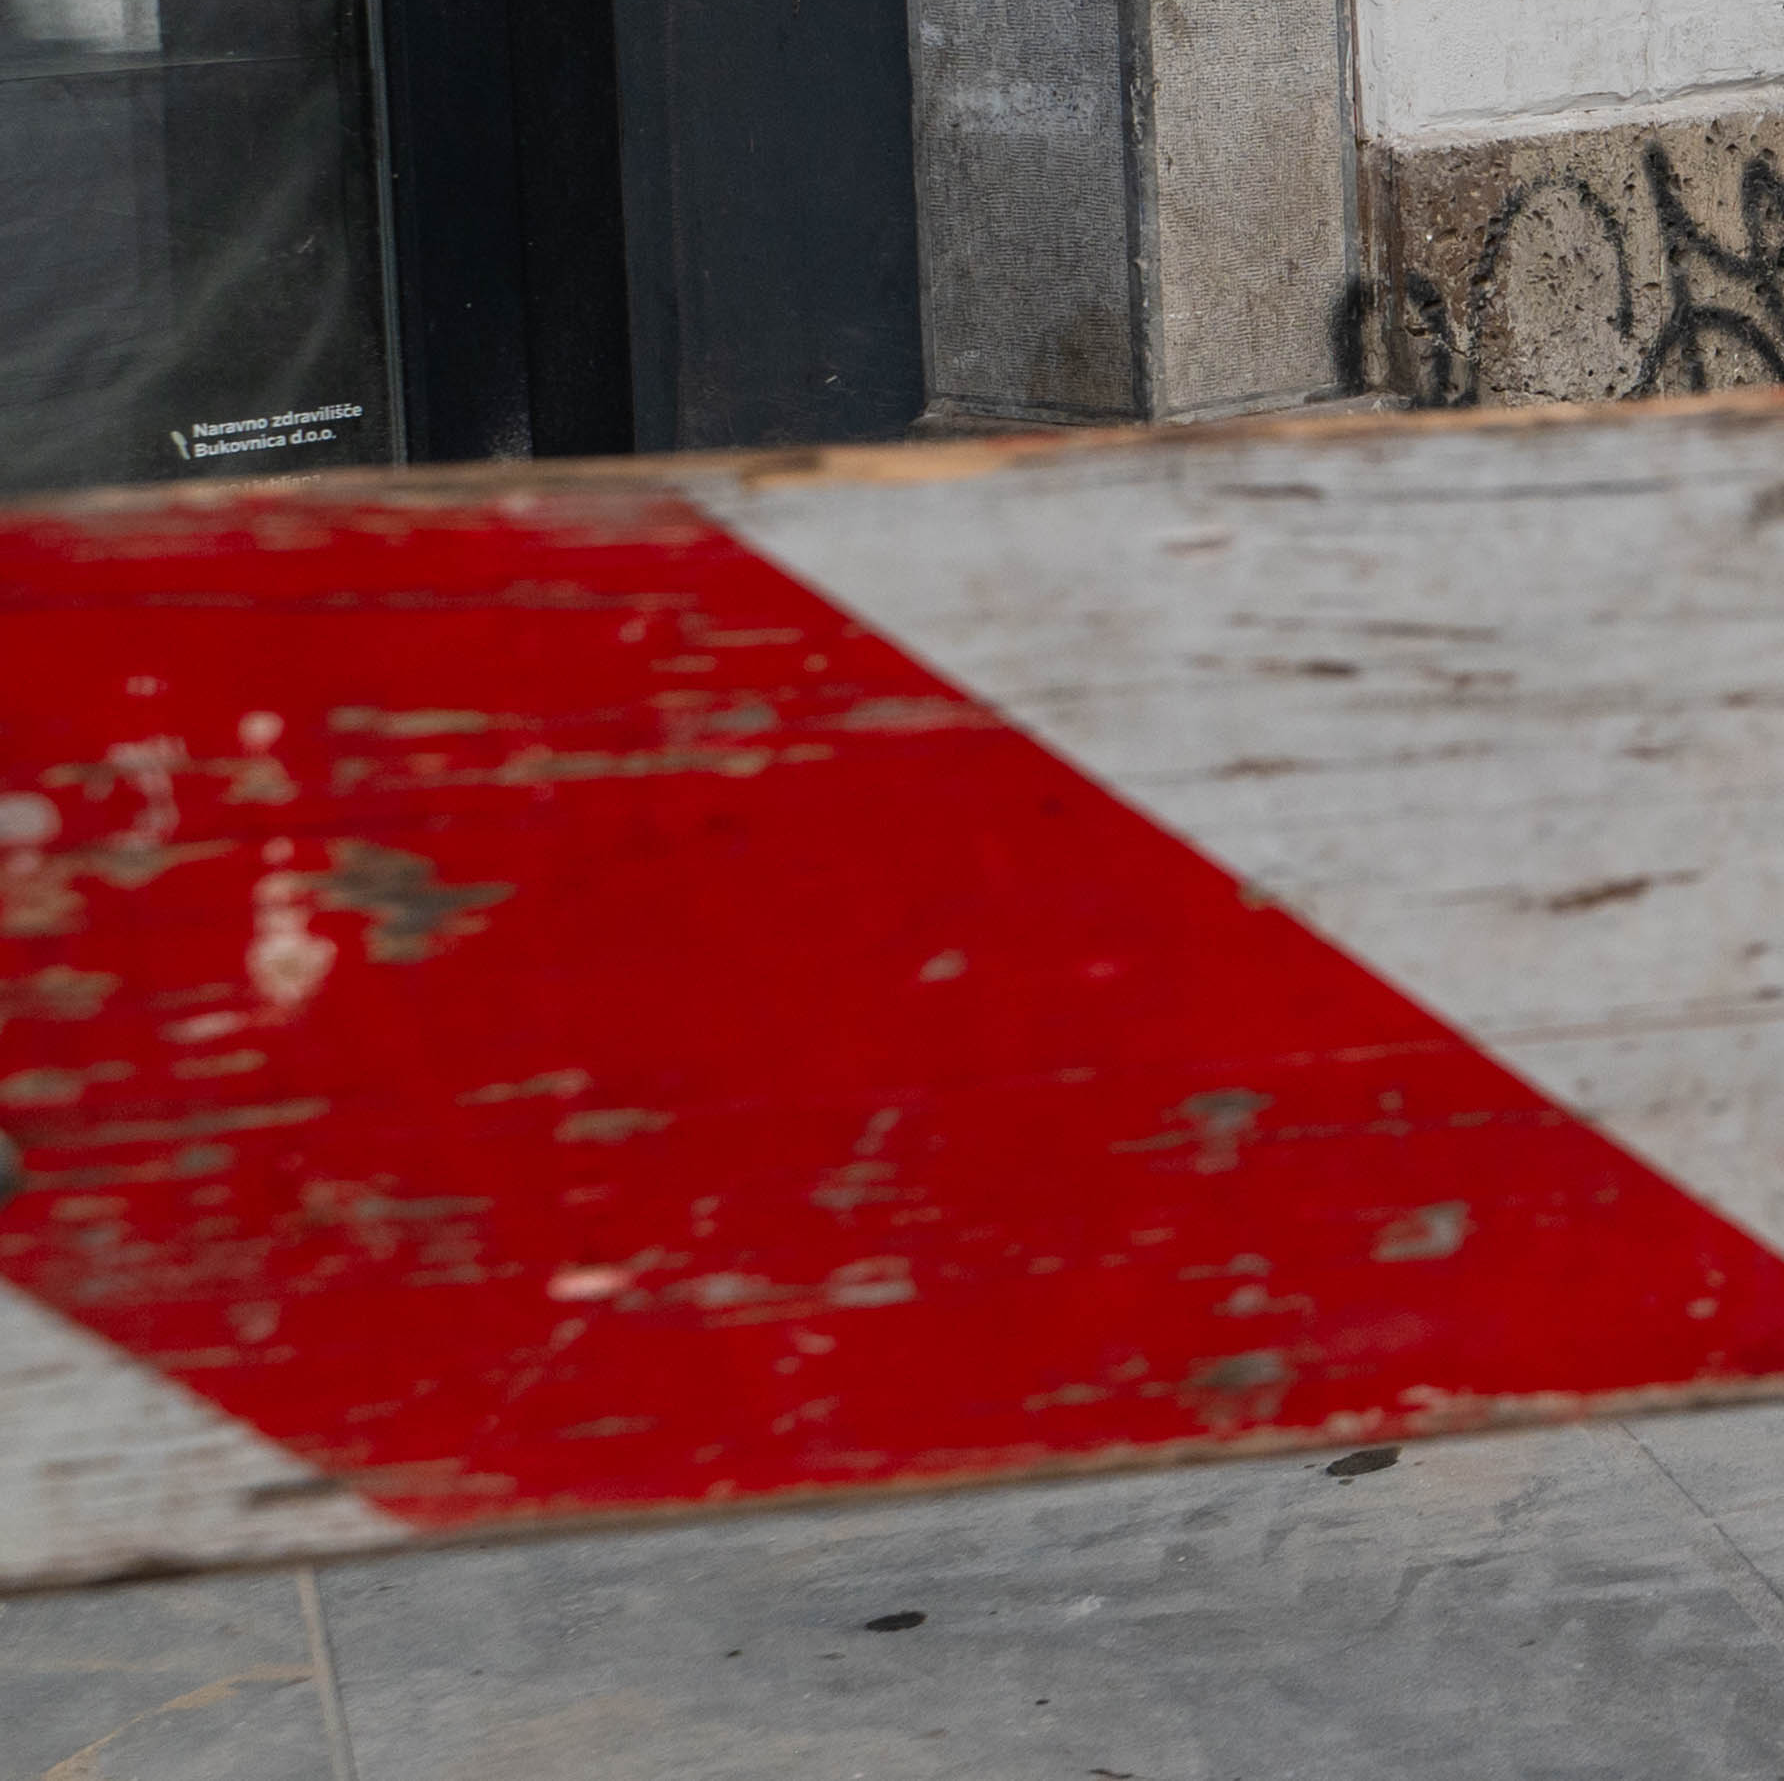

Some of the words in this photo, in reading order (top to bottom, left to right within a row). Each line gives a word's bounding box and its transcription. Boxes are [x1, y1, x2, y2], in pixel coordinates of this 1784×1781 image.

[193, 417, 269, 439] Naravno
[271, 403, 363, 429] zdravilišče
[193, 433, 287, 459] Bukovnica
[290, 427, 337, 446] d.o.o.
